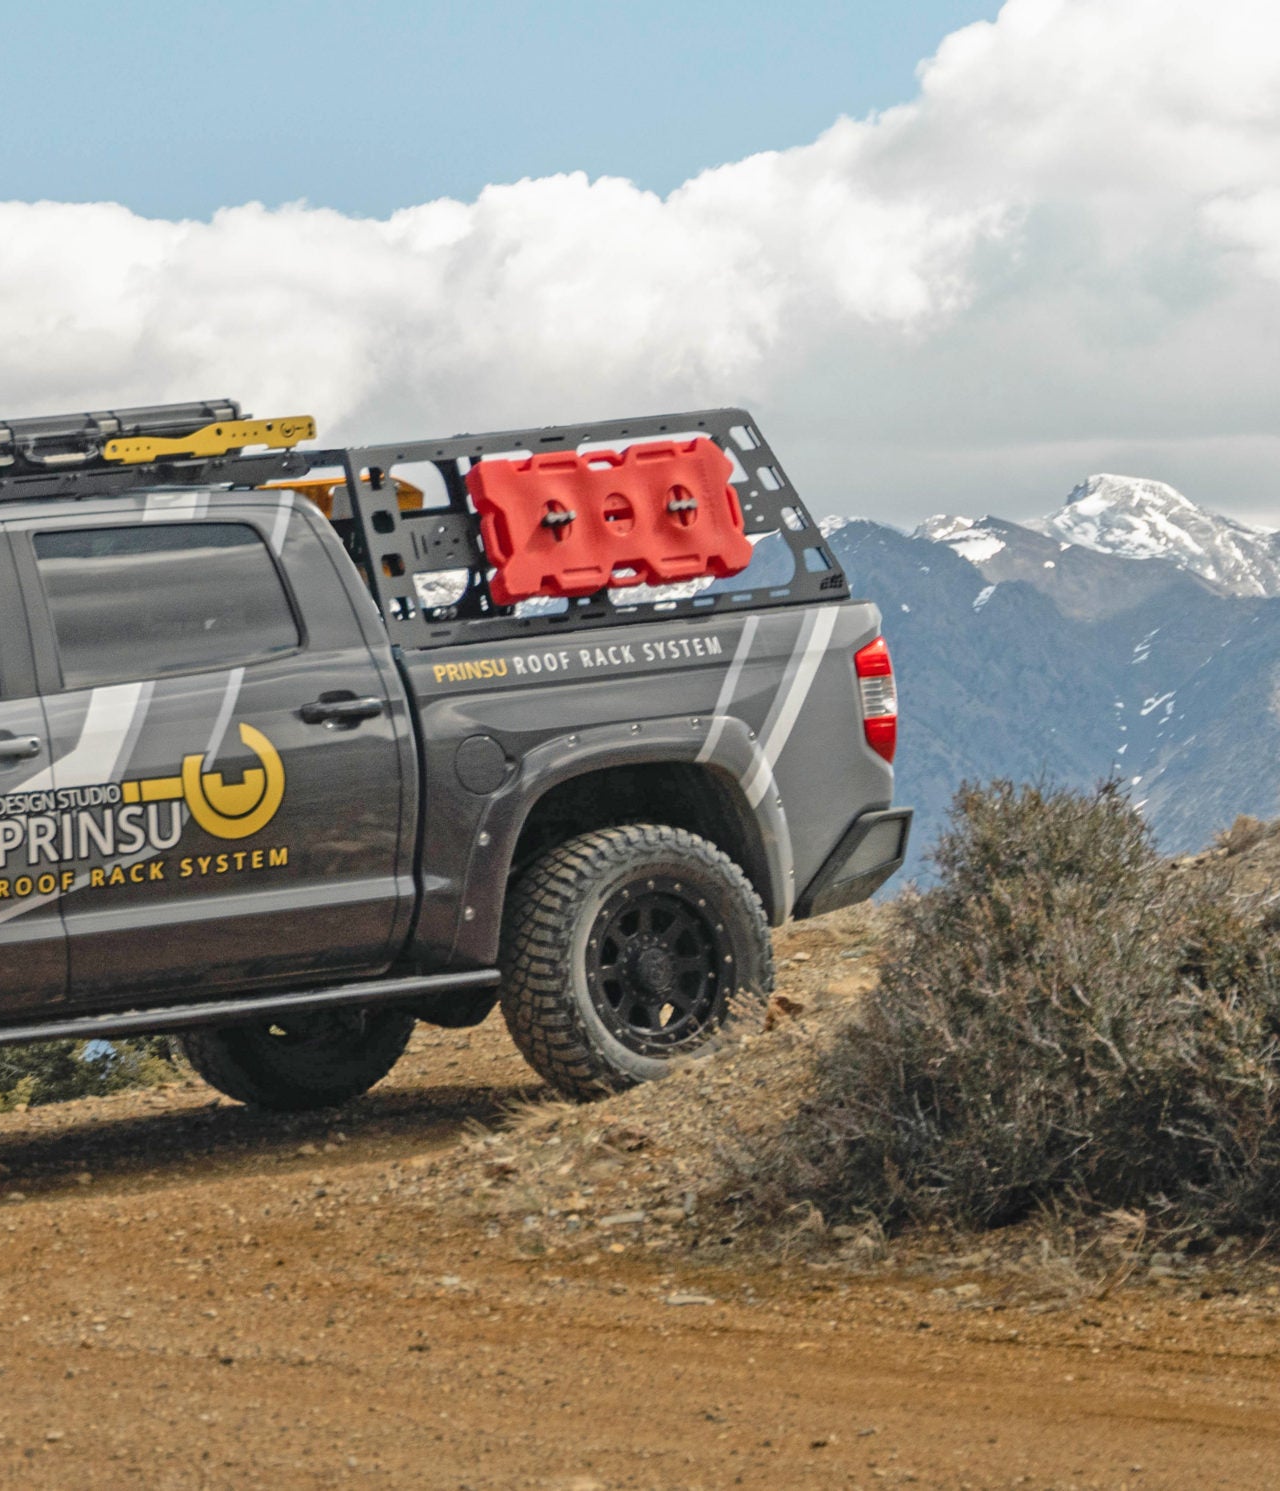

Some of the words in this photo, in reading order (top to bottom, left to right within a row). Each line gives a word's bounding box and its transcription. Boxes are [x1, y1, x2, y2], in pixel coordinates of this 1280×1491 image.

[433, 658, 508, 683] PRINSU
[512, 651, 570, 675] ROOF
[579, 645, 636, 668] RACK
[643, 636, 722, 662] SYSTEM
[56, 784, 121, 809] STUDIO
[90, 862, 165, 888] RACK
[179, 847, 289, 878] SYSTEM
